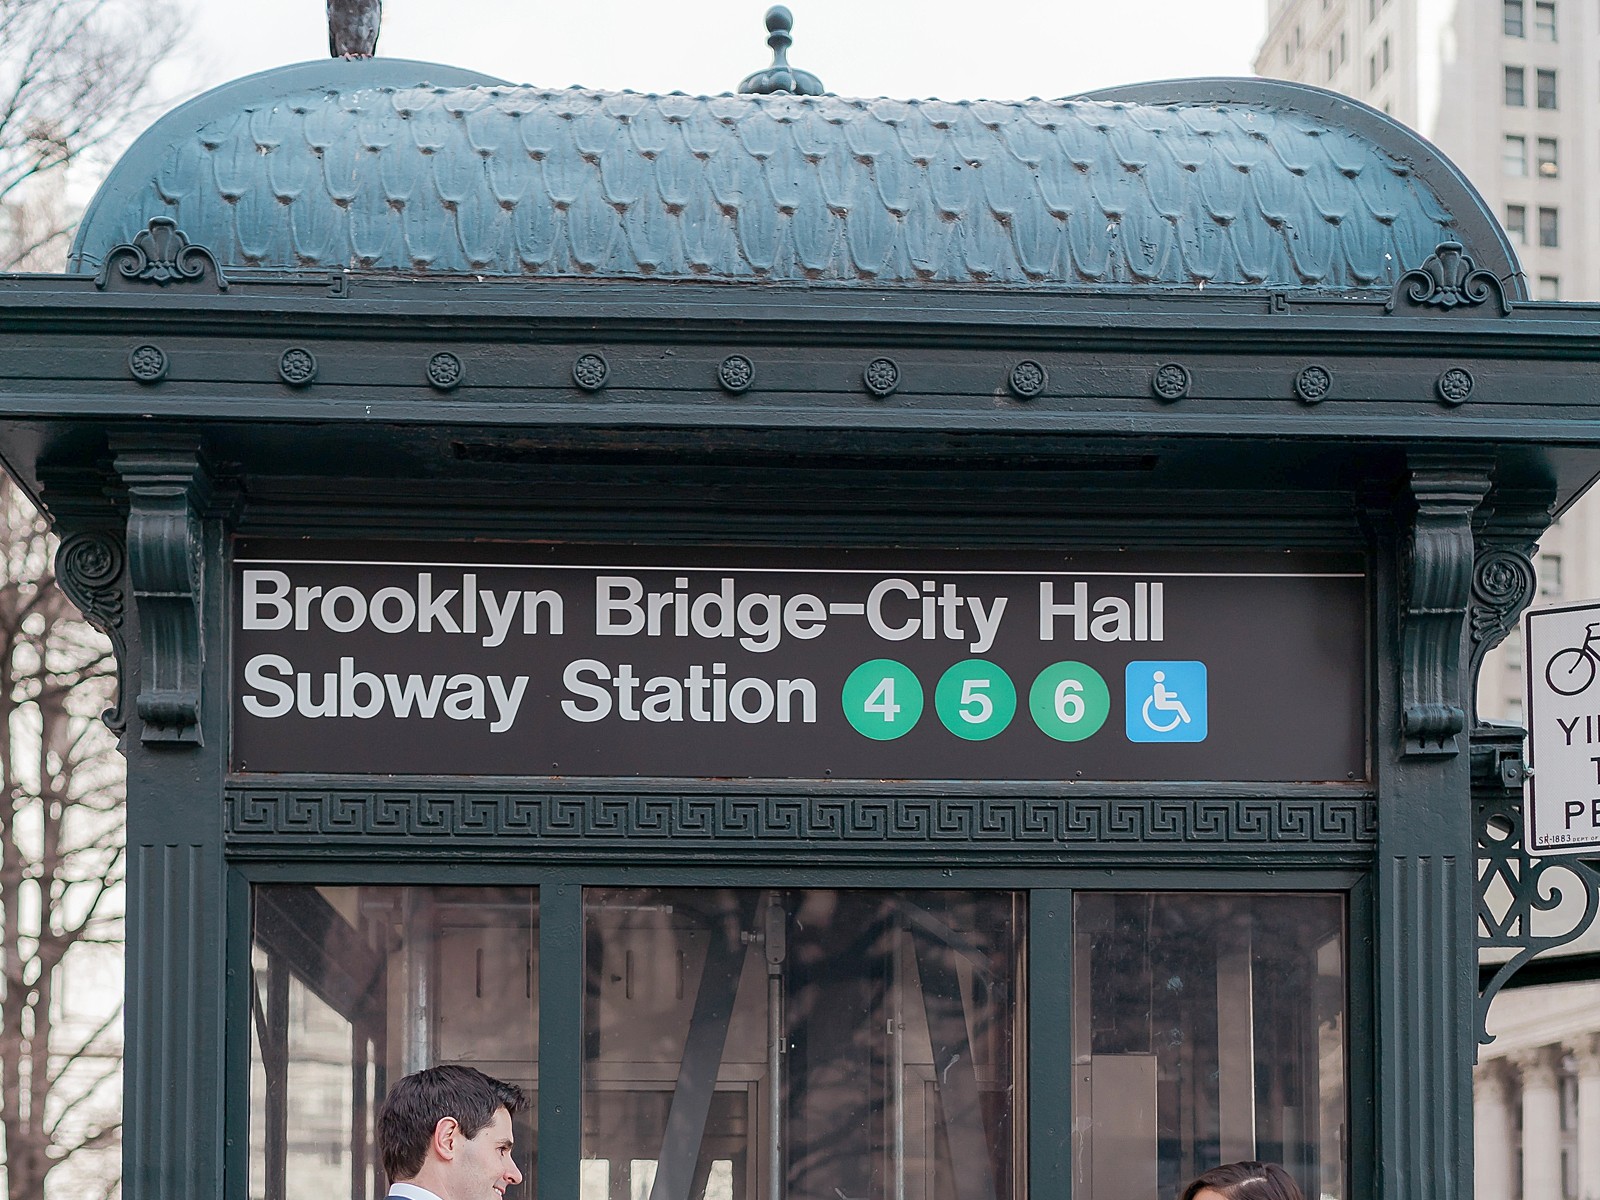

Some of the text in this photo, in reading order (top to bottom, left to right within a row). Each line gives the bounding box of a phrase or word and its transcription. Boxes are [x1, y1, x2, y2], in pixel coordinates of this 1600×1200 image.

[242, 569, 564, 648] Brooklyn
[1039, 581, 1165, 642] Hall
[242, 653, 1086, 733] Subway Station 4 5 6
[1556, 714, 1600, 746] YI
